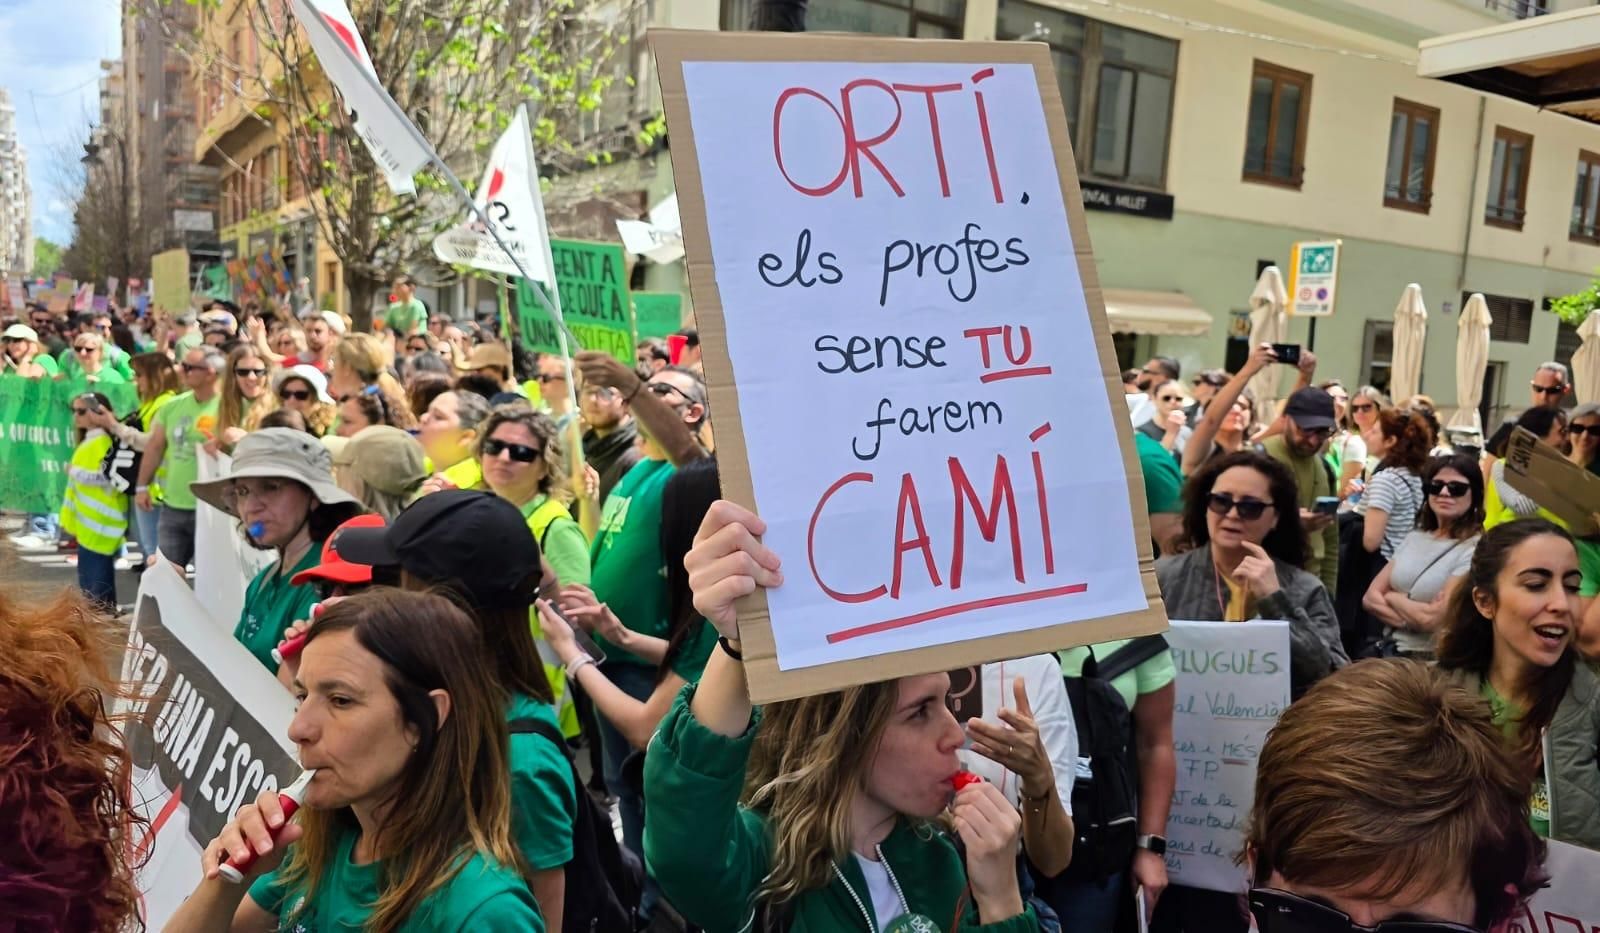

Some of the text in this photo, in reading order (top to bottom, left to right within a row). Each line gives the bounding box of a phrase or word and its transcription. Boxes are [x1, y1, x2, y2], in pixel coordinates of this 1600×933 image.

[758, 223, 1030, 305] els profes
[815, 325, 1033, 374] sense TU
[852, 398, 1003, 461] farem
[807, 423, 1055, 603] CAMÍ
[153, 673, 215, 780] UNA
